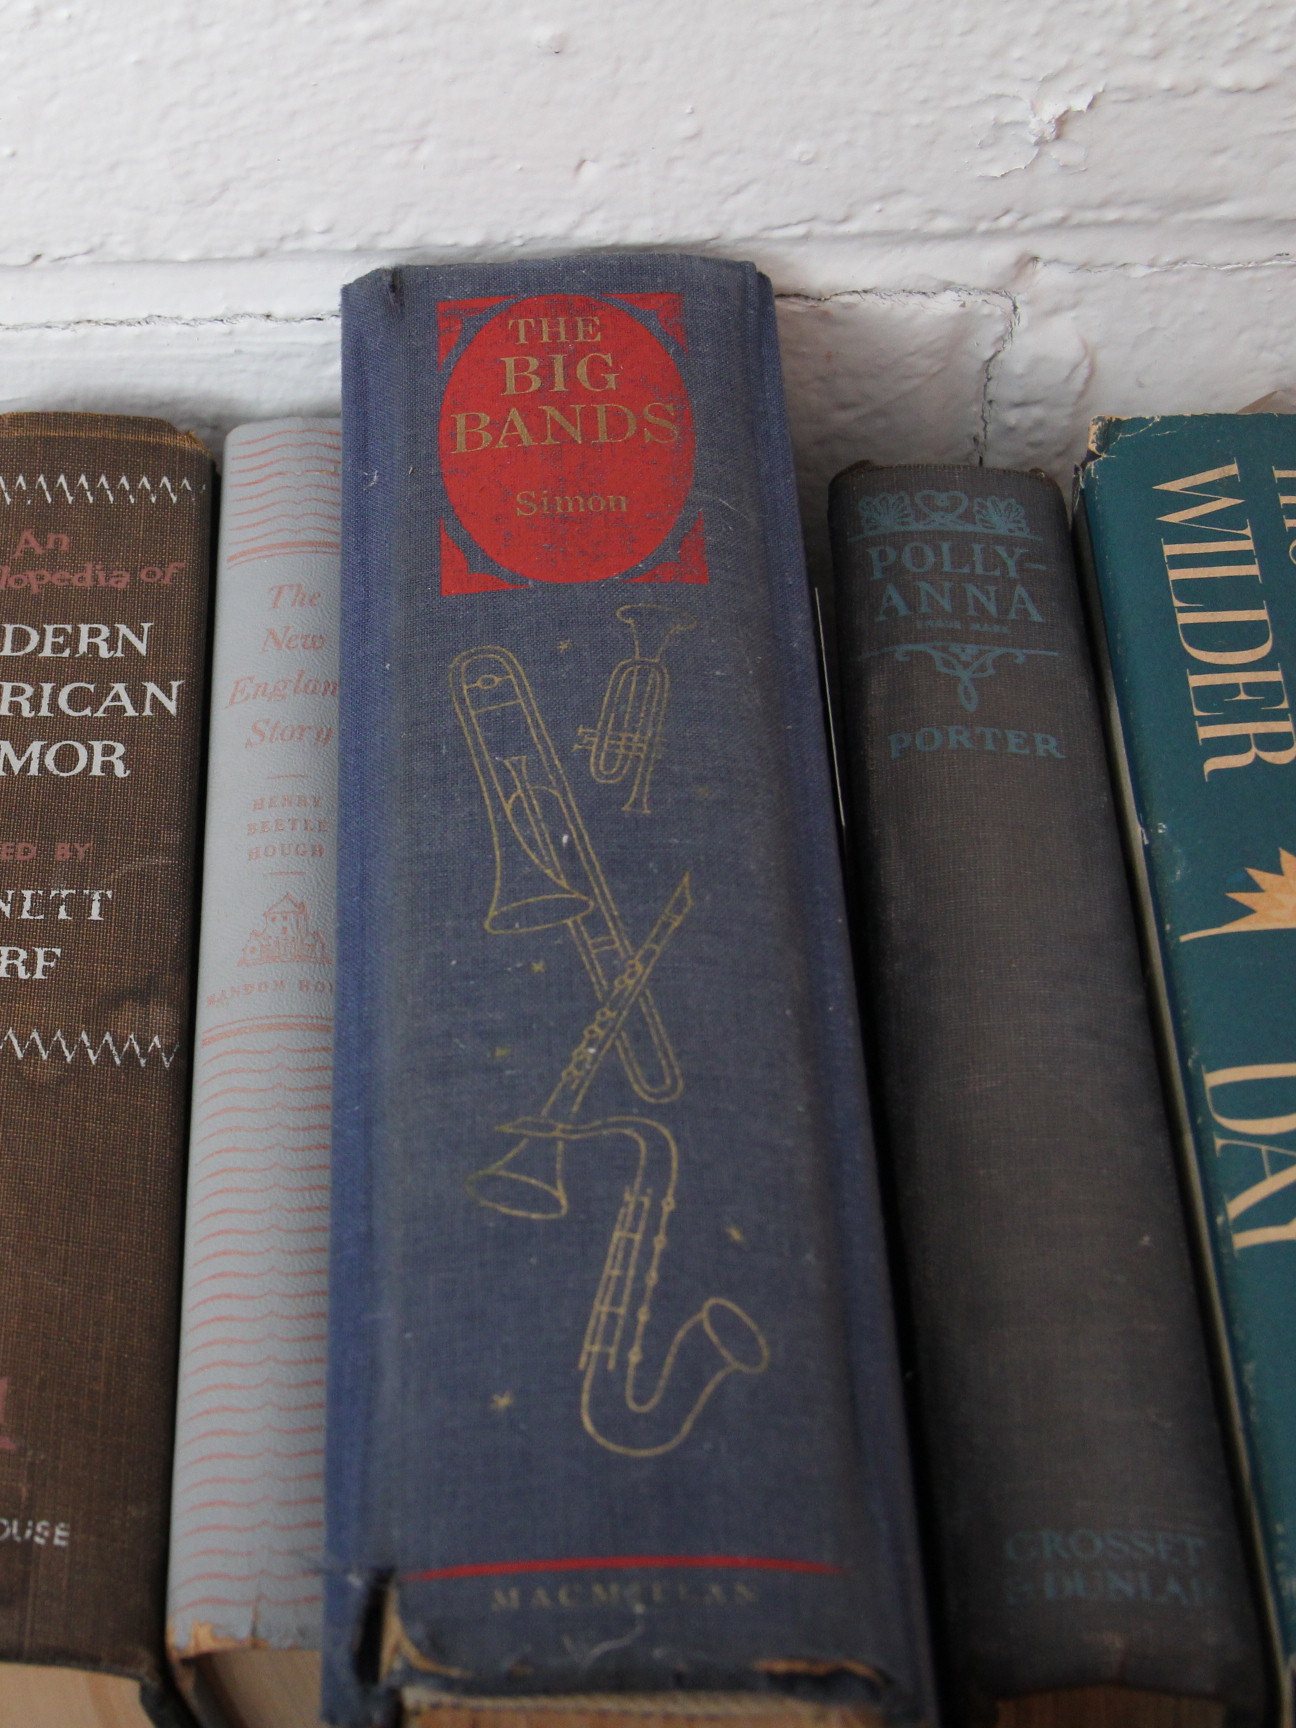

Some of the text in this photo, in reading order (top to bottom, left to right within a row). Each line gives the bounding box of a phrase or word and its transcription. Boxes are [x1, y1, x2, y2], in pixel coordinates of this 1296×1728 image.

[508, 316, 602, 345] THE
[500, 352, 619, 396] BIG
[449, 402, 679, 454] BANDS
[516, 490, 628, 516] Simon
[12, 529, 71, 557] An
[140, 562, 186, 586] of
[866, 541, 1047, 580] POLLY-
[268, 583, 321, 609] The
[874, 580, 1046, 624] ANNA
[1151, 457, 1296, 781] WILDER
[261, 625, 326, 654] New
[225, 669, 341, 709] Englan
[244, 718, 335, 749] Story
[888, 724, 1067, 759] PORTER
[55, 842, 94, 862] BY
[248, 843, 326, 861] HOUGH
